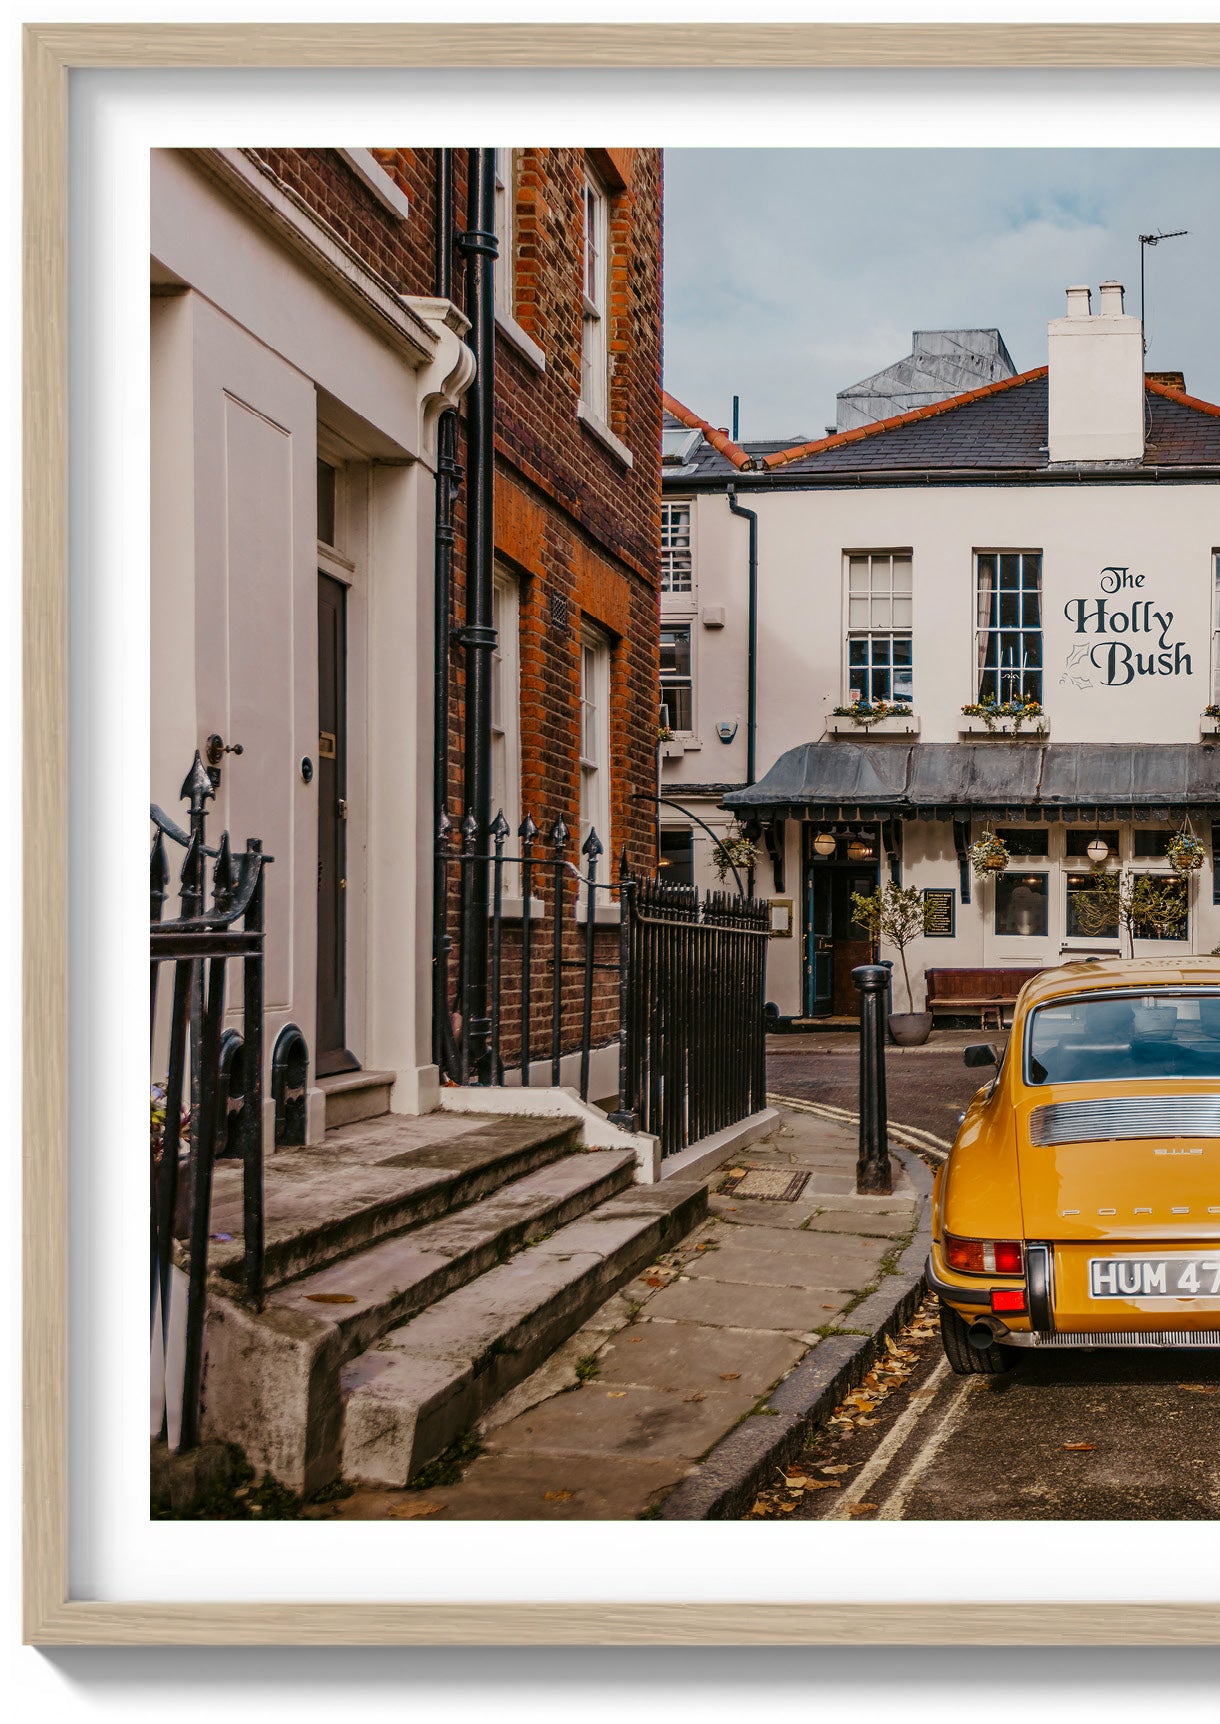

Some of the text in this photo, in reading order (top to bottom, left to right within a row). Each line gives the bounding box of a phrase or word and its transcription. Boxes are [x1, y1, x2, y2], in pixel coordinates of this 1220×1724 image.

[1100, 567, 1146, 594] The
[1064, 598, 1174, 650] Holly
[1090, 641, 1193, 686] Bush
[1092, 1262, 1167, 1294] HUM
